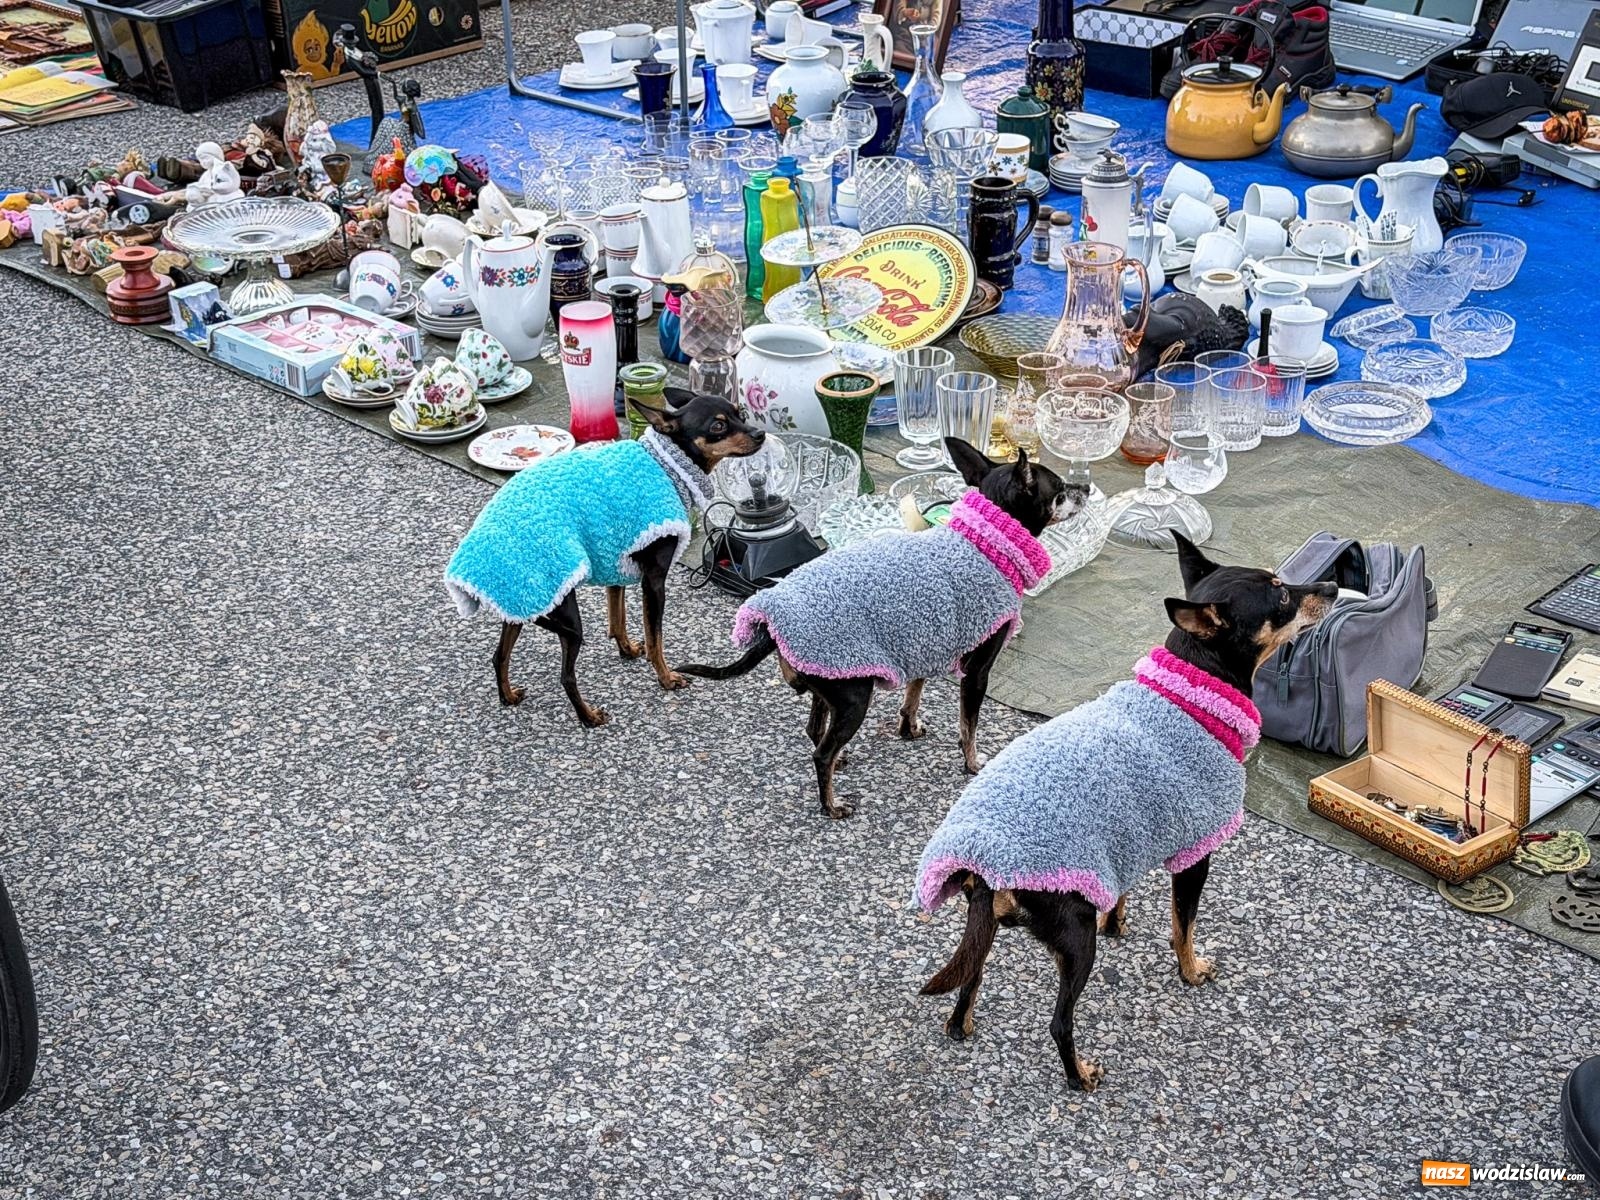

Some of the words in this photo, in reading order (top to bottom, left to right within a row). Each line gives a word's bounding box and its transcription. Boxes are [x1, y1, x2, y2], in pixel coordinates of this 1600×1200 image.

[1520, 25, 1576, 38] ASPIRE
[853, 240, 923, 263] DELICIOUS
[925, 248, 953, 308] REFRESHING
[880, 260, 926, 289] DRINK
[881, 328, 897, 341] CO
[902, 327, 935, 349] TORONTO
[563, 354, 588, 364] YSKIE
